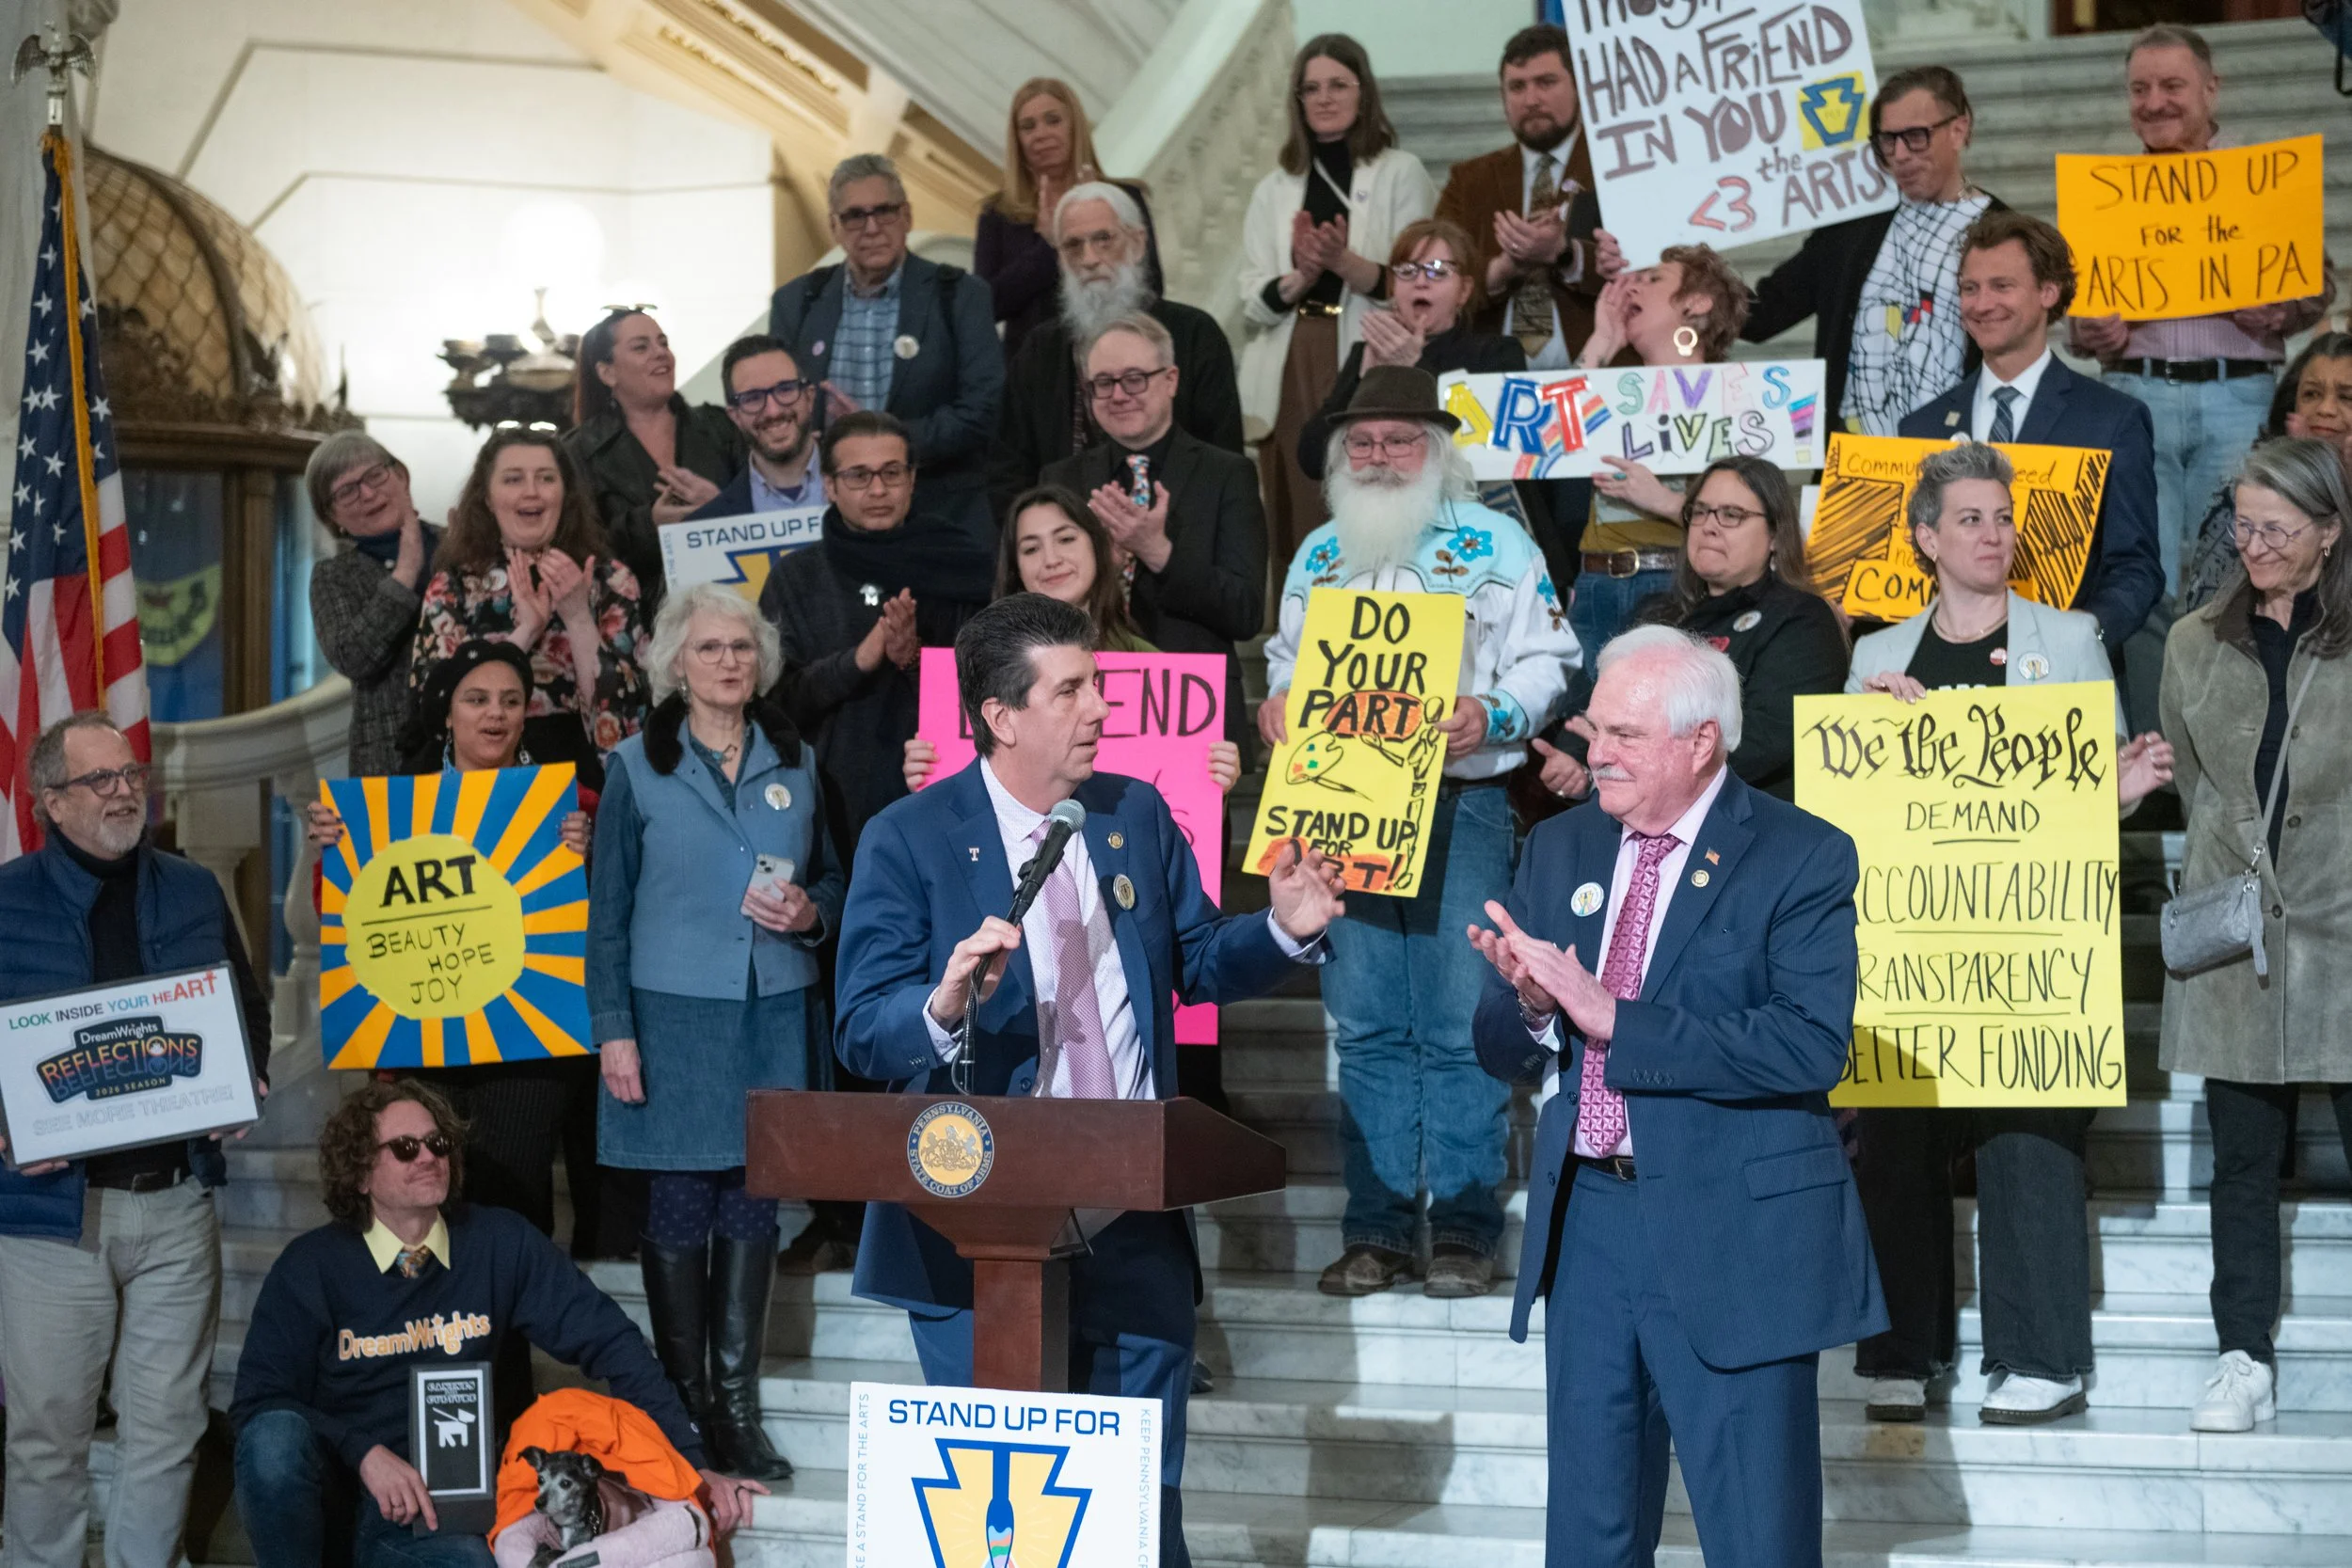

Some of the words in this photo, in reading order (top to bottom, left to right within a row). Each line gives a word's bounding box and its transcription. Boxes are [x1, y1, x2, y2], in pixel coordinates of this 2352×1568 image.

[1580, 36, 1668, 123] HAD
[1675, 53, 1701, 93] A
[1597, 114, 1677, 180] IN
[1682, 90, 1786, 163] YOU
[1756, 146, 1803, 182] the
[1783, 146, 1886, 227] ARTS
[2090, 158, 2218, 211] STAND
[2247, 149, 2298, 197] UP
[2200, 214, 2245, 245] the
[2087, 255, 2169, 313] ARTS
[2200, 253, 2232, 302] IN
[2256, 241, 2309, 300] PA
[1445, 374, 1593, 455] ART
[1616, 362, 1793, 415] SAVES
[2010, 459, 2058, 485] eed
[687, 523, 766, 549] STAND
[771, 518, 803, 538] UP
[1350, 595, 1411, 644] DO
[1318, 640, 1428, 695] YOUR
[1297, 689, 1422, 739] PART
[1802, 715, 1890, 780] We
[1893, 712, 1966, 780] the
[1953, 704, 2106, 792] People
[1265, 805, 1370, 841] STAND
[1376, 817, 1416, 849] UP
[1905, 799, 2041, 833] DEMAND
[1309, 838, 1354, 858] FOR
[378, 854, 477, 909] ART
[1857, 860, 2119, 936] CCOUNTABILITY
[366, 923, 466, 959] BEAUTY
[428, 942, 496, 974] HOPE
[8, 1011, 53, 1031] LOOK
[56, 1003, 104, 1022] INSIDE
[107, 993, 150, 1013] YOUR
[152, 968, 218, 1006] HEART
[409, 974, 463, 1005] JOY
[1856, 946, 2094, 1015] RANSPARENCY
[80, 1022, 159, 1045] DreamWrights
[41, 1035, 199, 1085] REFLECTIONS
[1979, 1024, 2122, 1092] FUNDING
[33, 1116, 72, 1136] SEE
[77, 1103, 135, 1129] MORE
[138, 1084, 234, 1116] THEATRE!
[95, 1085, 120, 1097] 2026
[124, 1077, 167, 1091] SEASON
[913, 1104, 989, 1137] PENNSYLVANIA
[910, 1148, 930, 1183] STATE
[930, 1180, 959, 1195] COAT
[960, 1178, 975, 1193] OF
[975, 1150, 993, 1183] ARMS
[339, 1310, 491, 1361] DreamWrights
[859, 1393, 869, 1429] ARTS
[888, 1399, 996, 1429] STAND
[1004, 1406, 1047, 1432] UP
[1055, 1409, 1120, 1436] FOR
[1140, 1408, 1152, 1443] KEEP
[857, 1433, 868, 1458] THE
[857, 1463, 867, 1489] FOR
[1137, 1447, 1151, 1549] PENNSYLVANIA
[855, 1494, 866, 1539] STAND
[856, 1542, 866, 1551] A
